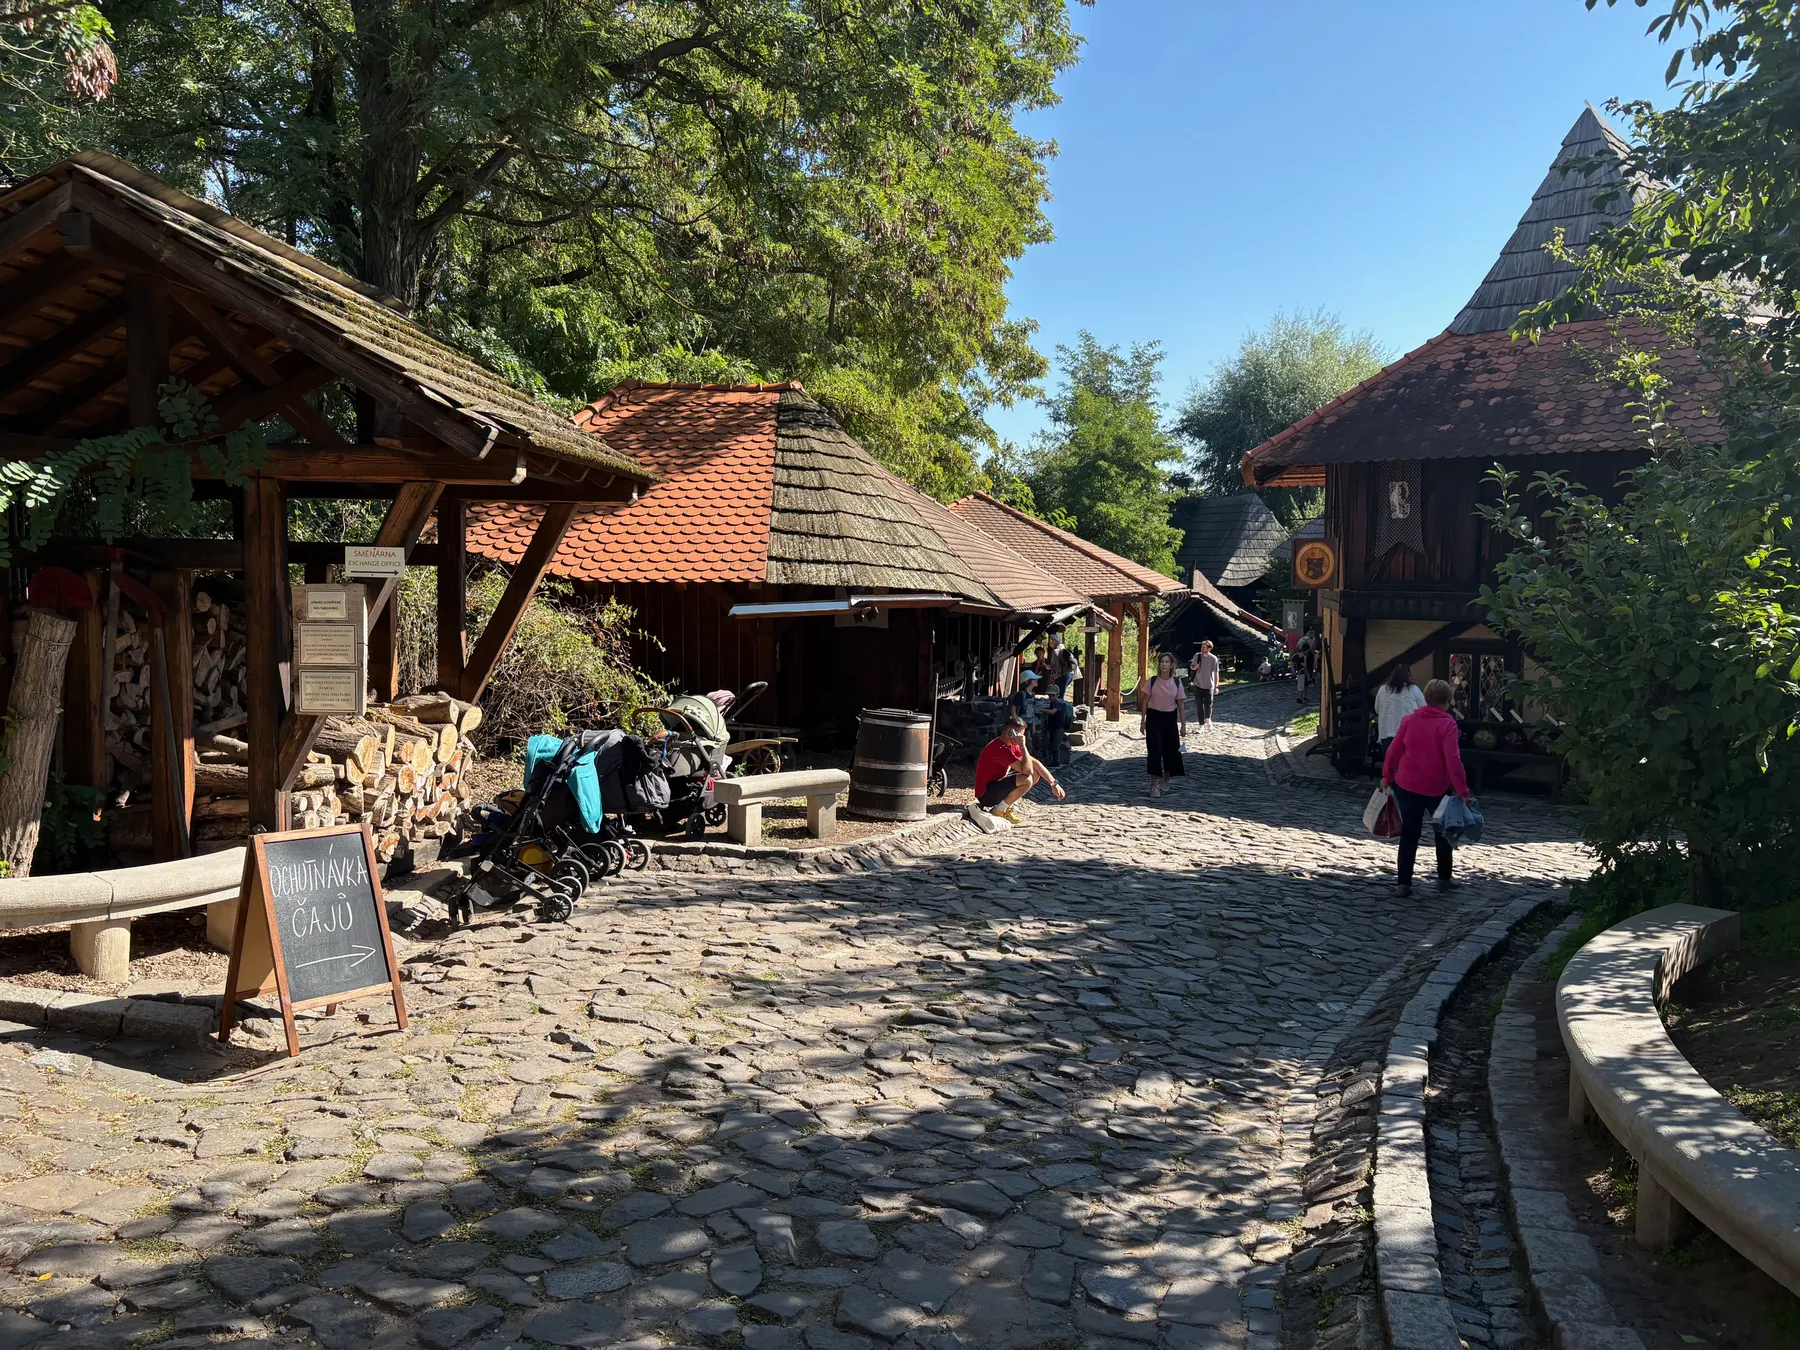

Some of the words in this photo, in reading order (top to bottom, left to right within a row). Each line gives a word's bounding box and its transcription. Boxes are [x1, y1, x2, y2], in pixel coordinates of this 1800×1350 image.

[353, 549, 397, 558] SMĚNÁRNA
[269, 842, 369, 898] OCHUTNÁVKA
[292, 892, 353, 938] ČAJŮ
